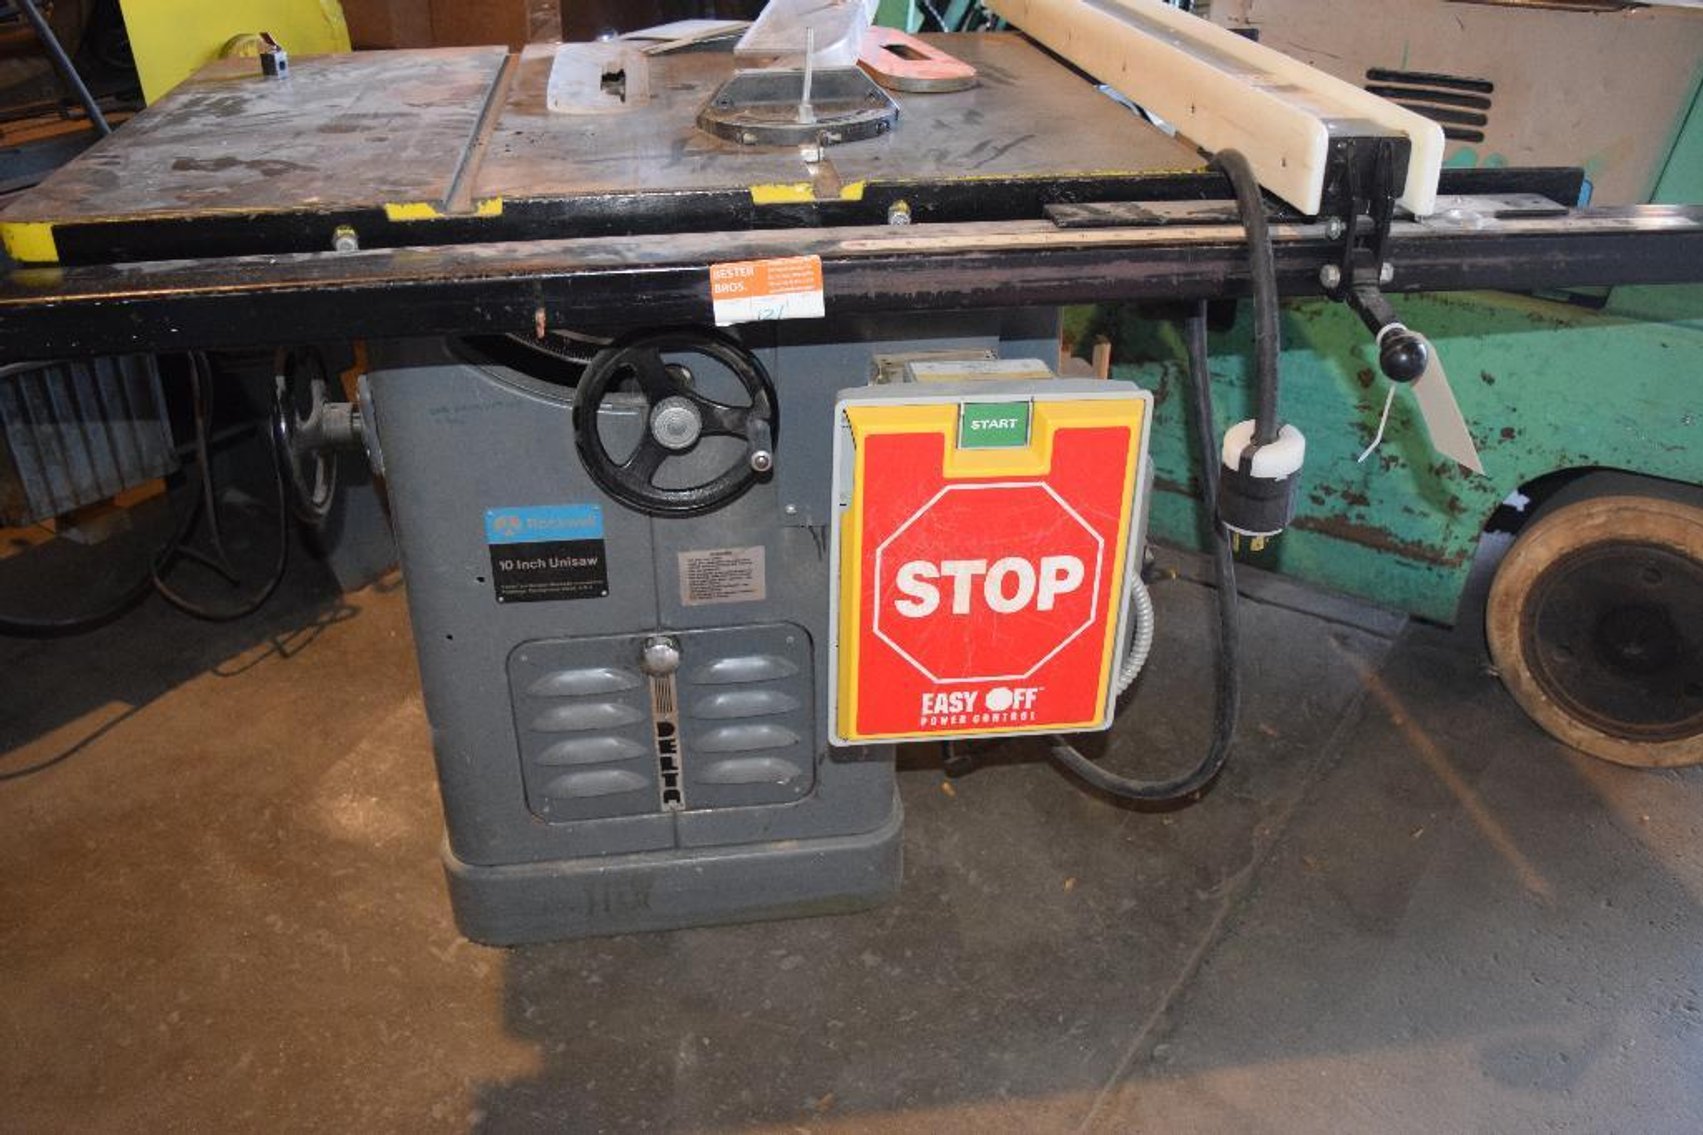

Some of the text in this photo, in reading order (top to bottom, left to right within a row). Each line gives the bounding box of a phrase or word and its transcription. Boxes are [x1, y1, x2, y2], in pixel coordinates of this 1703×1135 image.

[970, 418, 1018, 430] START
[499, 556, 598, 571] 10 Inch Unisaw
[894, 555, 1085, 618] STOP
[921, 690, 978, 715] EASY
[920, 711, 1037, 726] POWER CONTROL
[656, 721, 681, 804] DELTA
